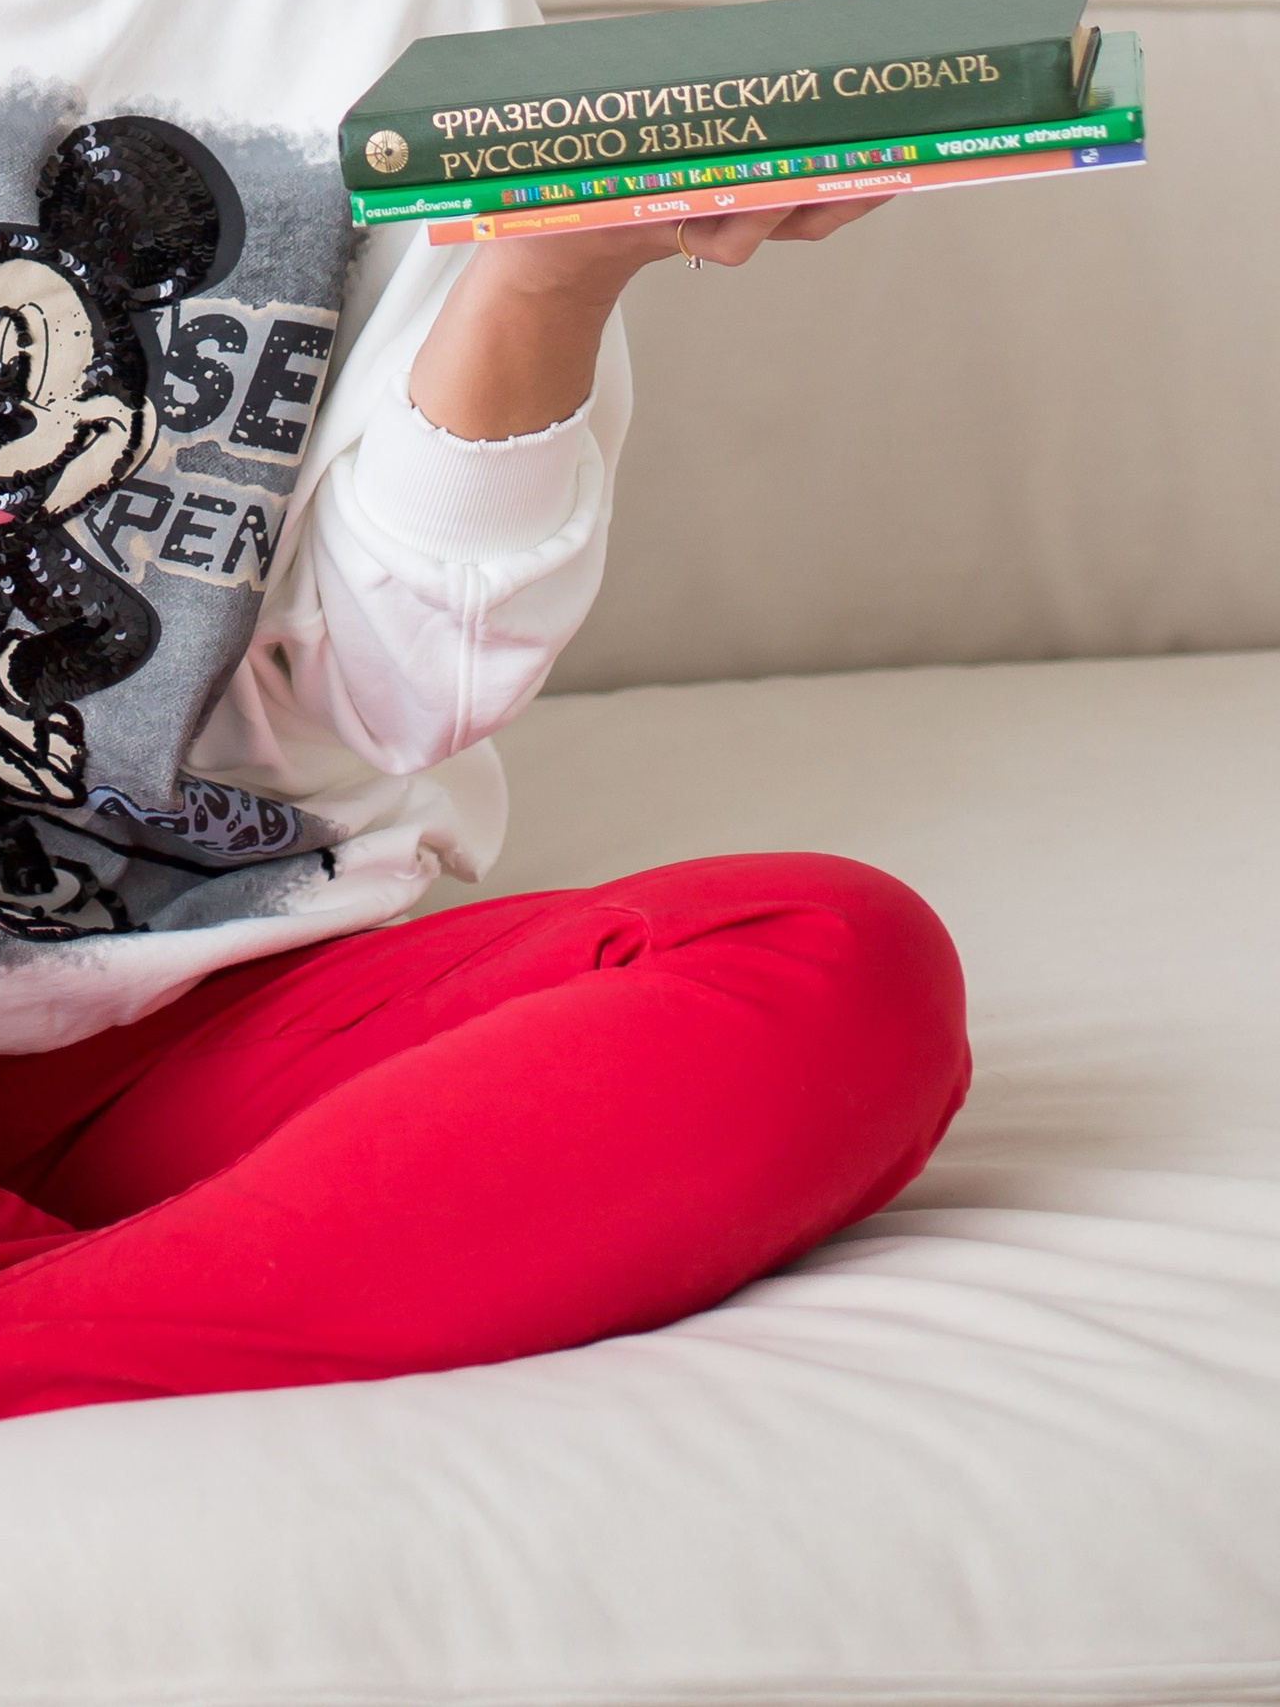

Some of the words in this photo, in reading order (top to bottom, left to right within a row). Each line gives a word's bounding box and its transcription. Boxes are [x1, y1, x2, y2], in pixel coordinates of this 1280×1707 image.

[432, 69, 822, 140] ФРАЗЕОЛОГИЧЕСКИЙ
[832, 54, 1001, 97] СЛОВАРЬ
[935, 134, 1021, 157] ЖУКОВА
[1024, 124, 1108, 145] Надежда
[439, 128, 627, 181] РУССКОГО
[637, 115, 768, 154] ЯЗЫКА
[845, 144, 919, 166] ПЕРВАЯ
[688, 160, 773, 184] БУКВАРЯ
[777, 153, 839, 175] ПОСЛЕ
[580, 175, 620, 197] ДЛЯ
[624, 170, 685, 192] КНИГА
[816, 178, 852, 193] язык
[852, 172, 912, 192] Русский
[500, 182, 575, 205] ЧТЕНИЯ
[633, 205, 643, 217] 2
[646, 198, 691, 214] Часть
[542, 213, 581, 226] Школа
